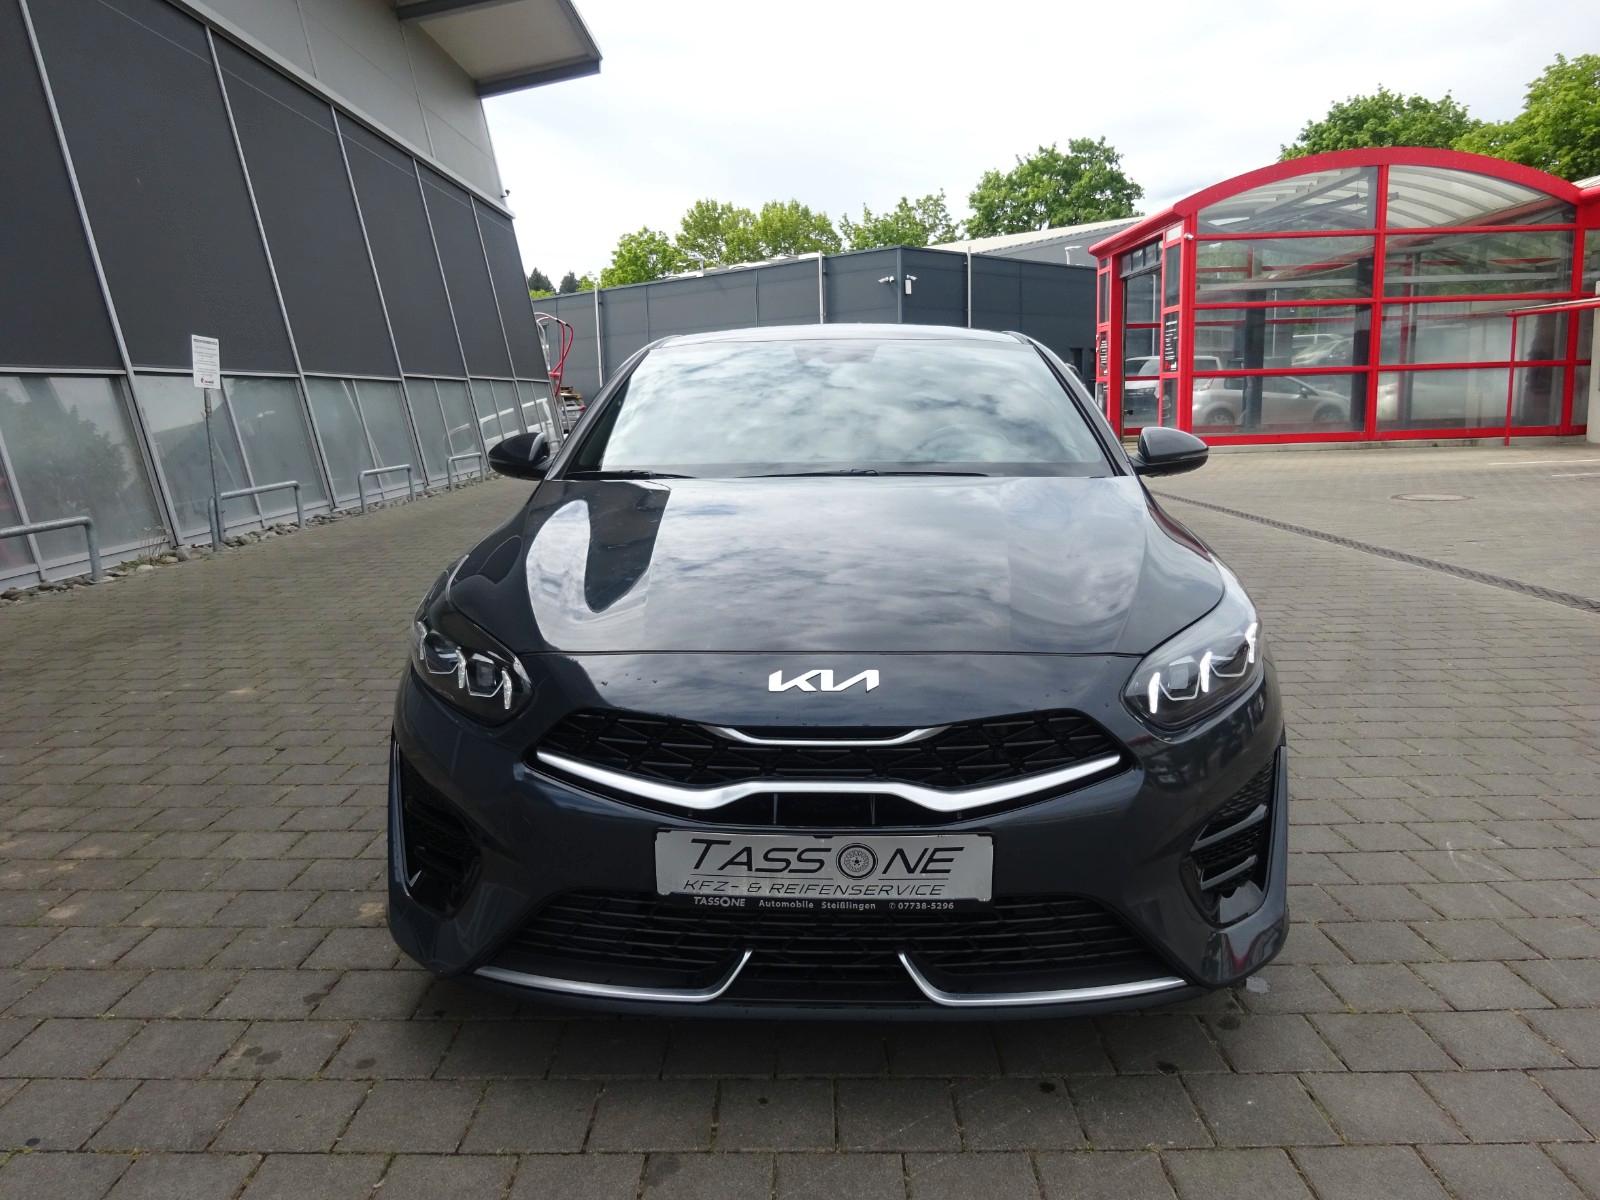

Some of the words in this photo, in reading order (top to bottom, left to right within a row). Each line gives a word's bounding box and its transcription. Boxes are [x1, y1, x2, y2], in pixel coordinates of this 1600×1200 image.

[768, 669, 880, 692] KIA
[689, 838, 966, 880] TASSONE
[683, 879, 739, 892] KFZ-
[768, 883, 946, 896] REIFENSERVICE
[693, 896, 746, 907] TASSONE
[759, 899, 814, 909] Automobile
[821, 901, 876, 911] Steißlingen
[897, 902, 955, 910] 07738-5296
